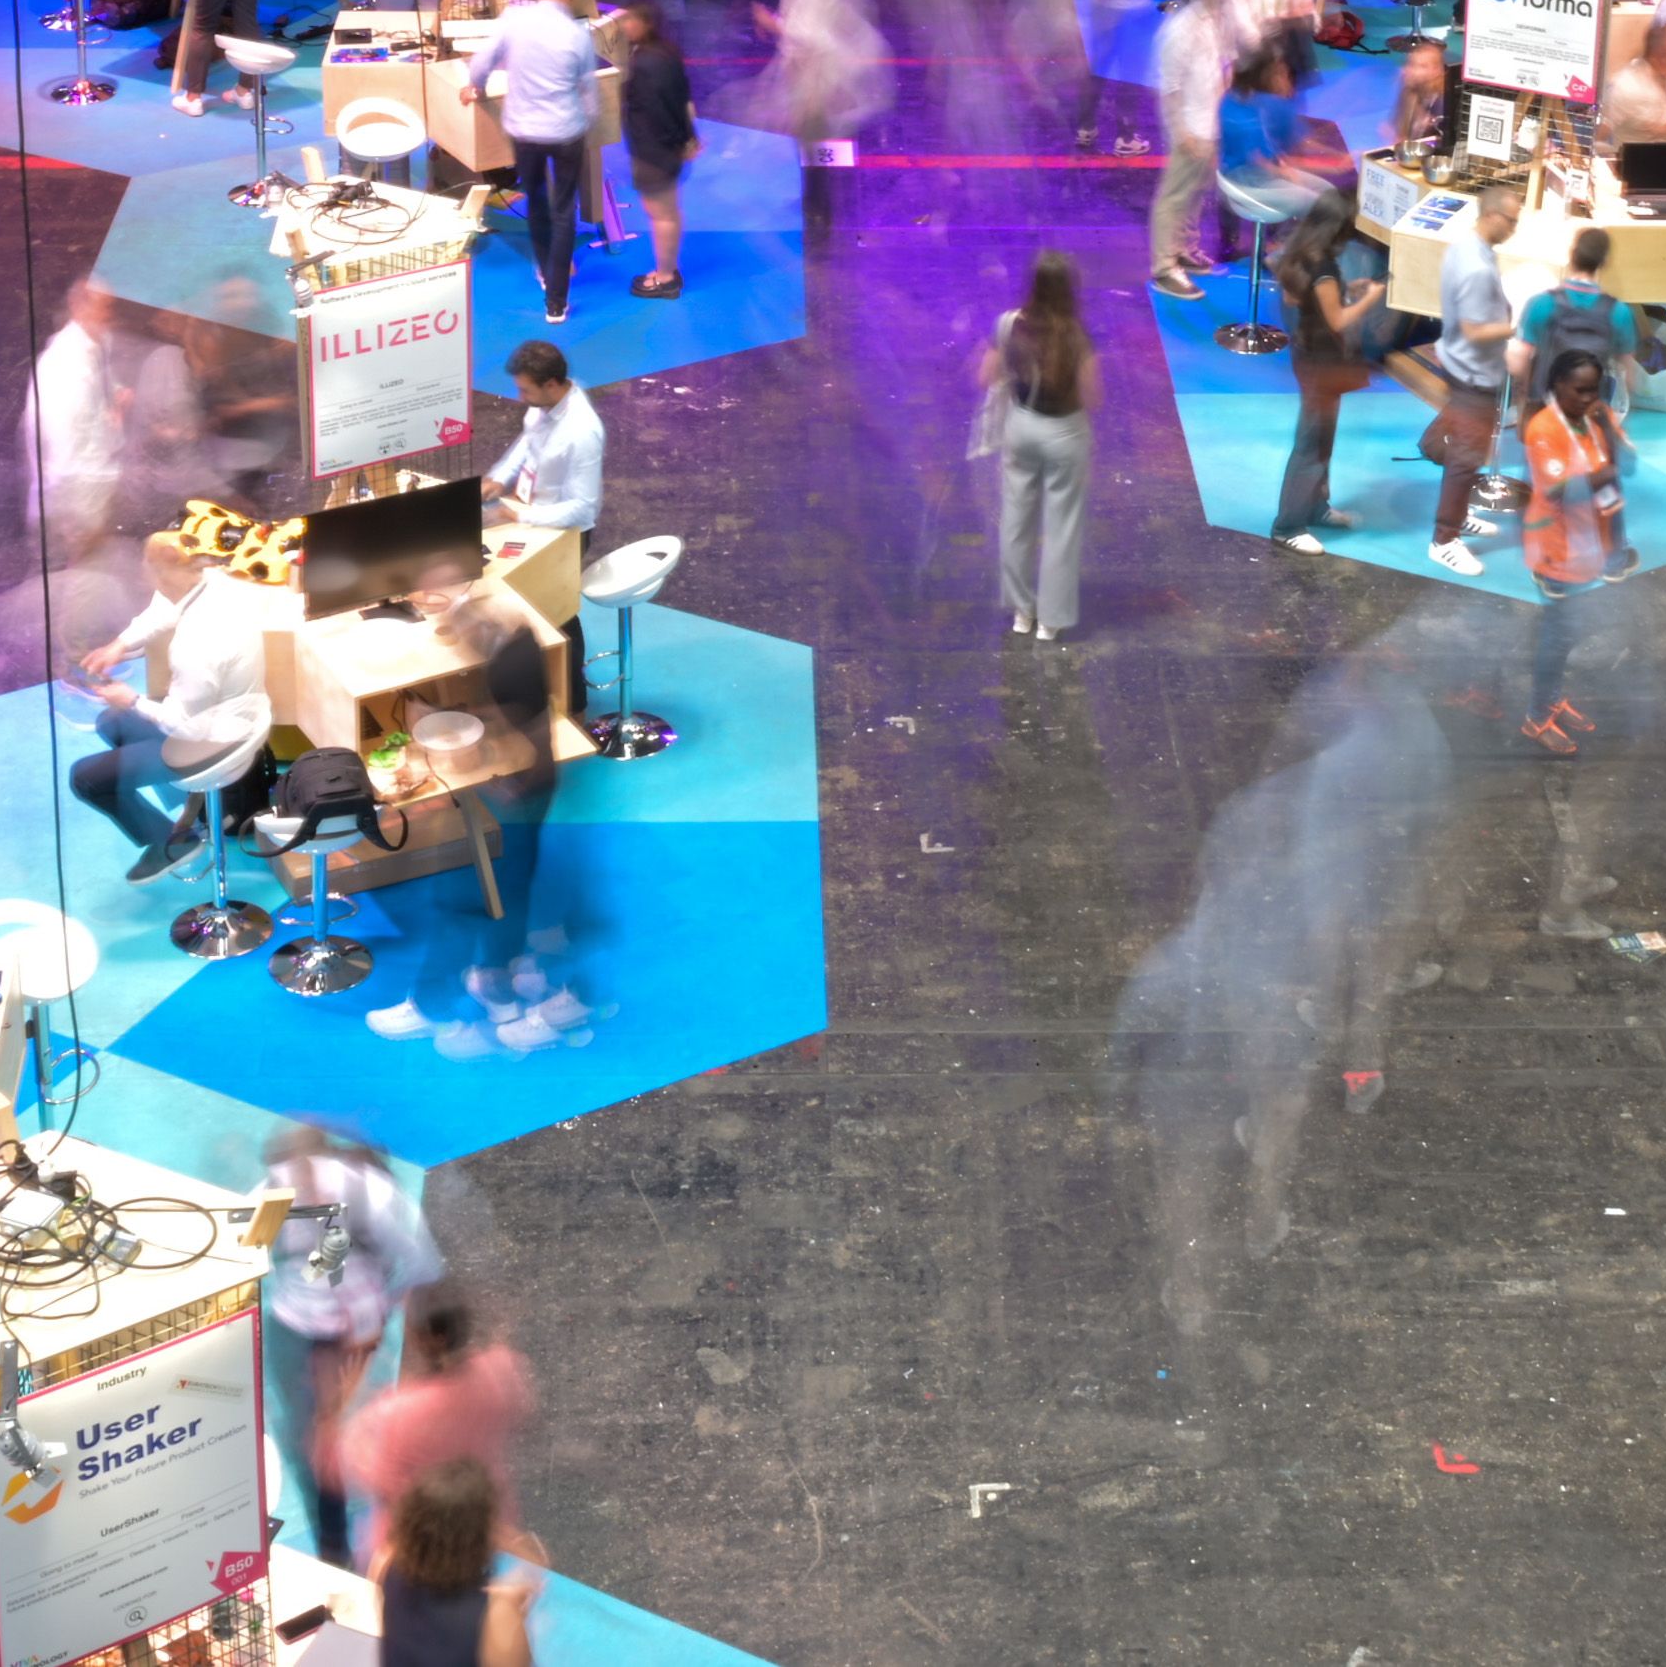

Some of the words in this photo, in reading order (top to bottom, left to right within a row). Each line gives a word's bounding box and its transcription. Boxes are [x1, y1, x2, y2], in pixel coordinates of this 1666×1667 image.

[319, 308, 460, 364] ILLIZEO
[95, 1365, 148, 1392] Industry
[75, 1403, 163, 1452] User
[76, 1416, 203, 1483] Shaker
[78, 1482, 110, 1500] Shake
[110, 1472, 133, 1488] Your
[134, 1459, 167, 1477] Future
[167, 1441, 206, 1463] Product
[206, 1423, 249, 1446] Creation
[98, 1507, 161, 1539] UserShaker
[180, 1506, 206, 1521] France
[72, 1550, 99, 1566] market
[223, 1554, 255, 1580] B50
[229, 1572, 249, 1588] 001
